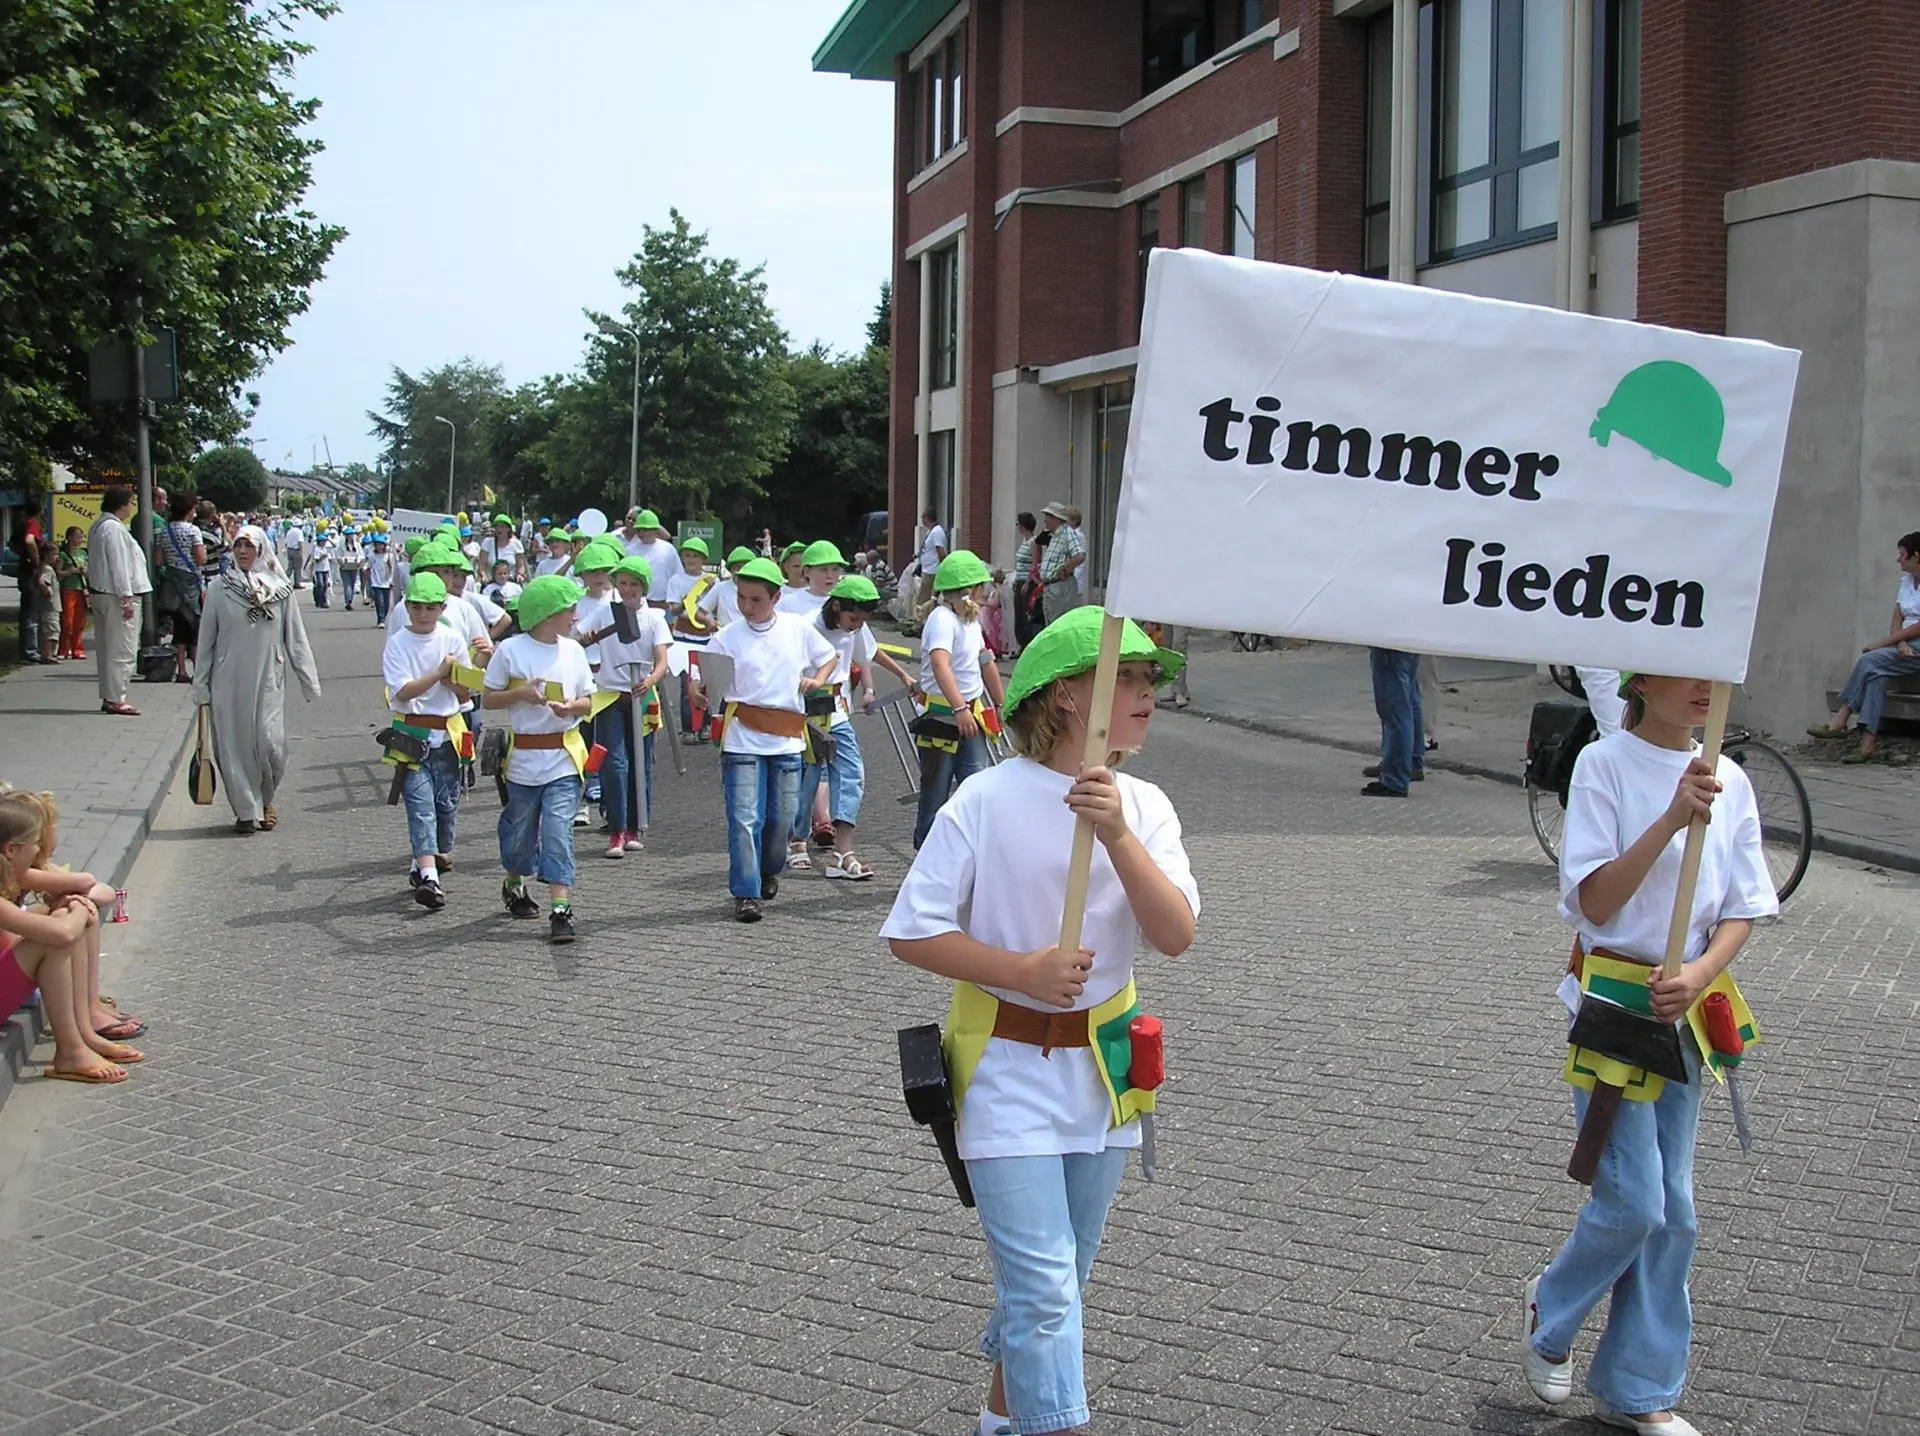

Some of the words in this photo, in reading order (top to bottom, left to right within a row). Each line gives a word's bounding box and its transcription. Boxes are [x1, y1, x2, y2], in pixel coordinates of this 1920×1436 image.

[1200, 396, 1560, 501] timmer
[57, 497, 96, 520] SCHALK
[392, 524, 433, 535] electric
[1442, 537, 1705, 629] lieden
